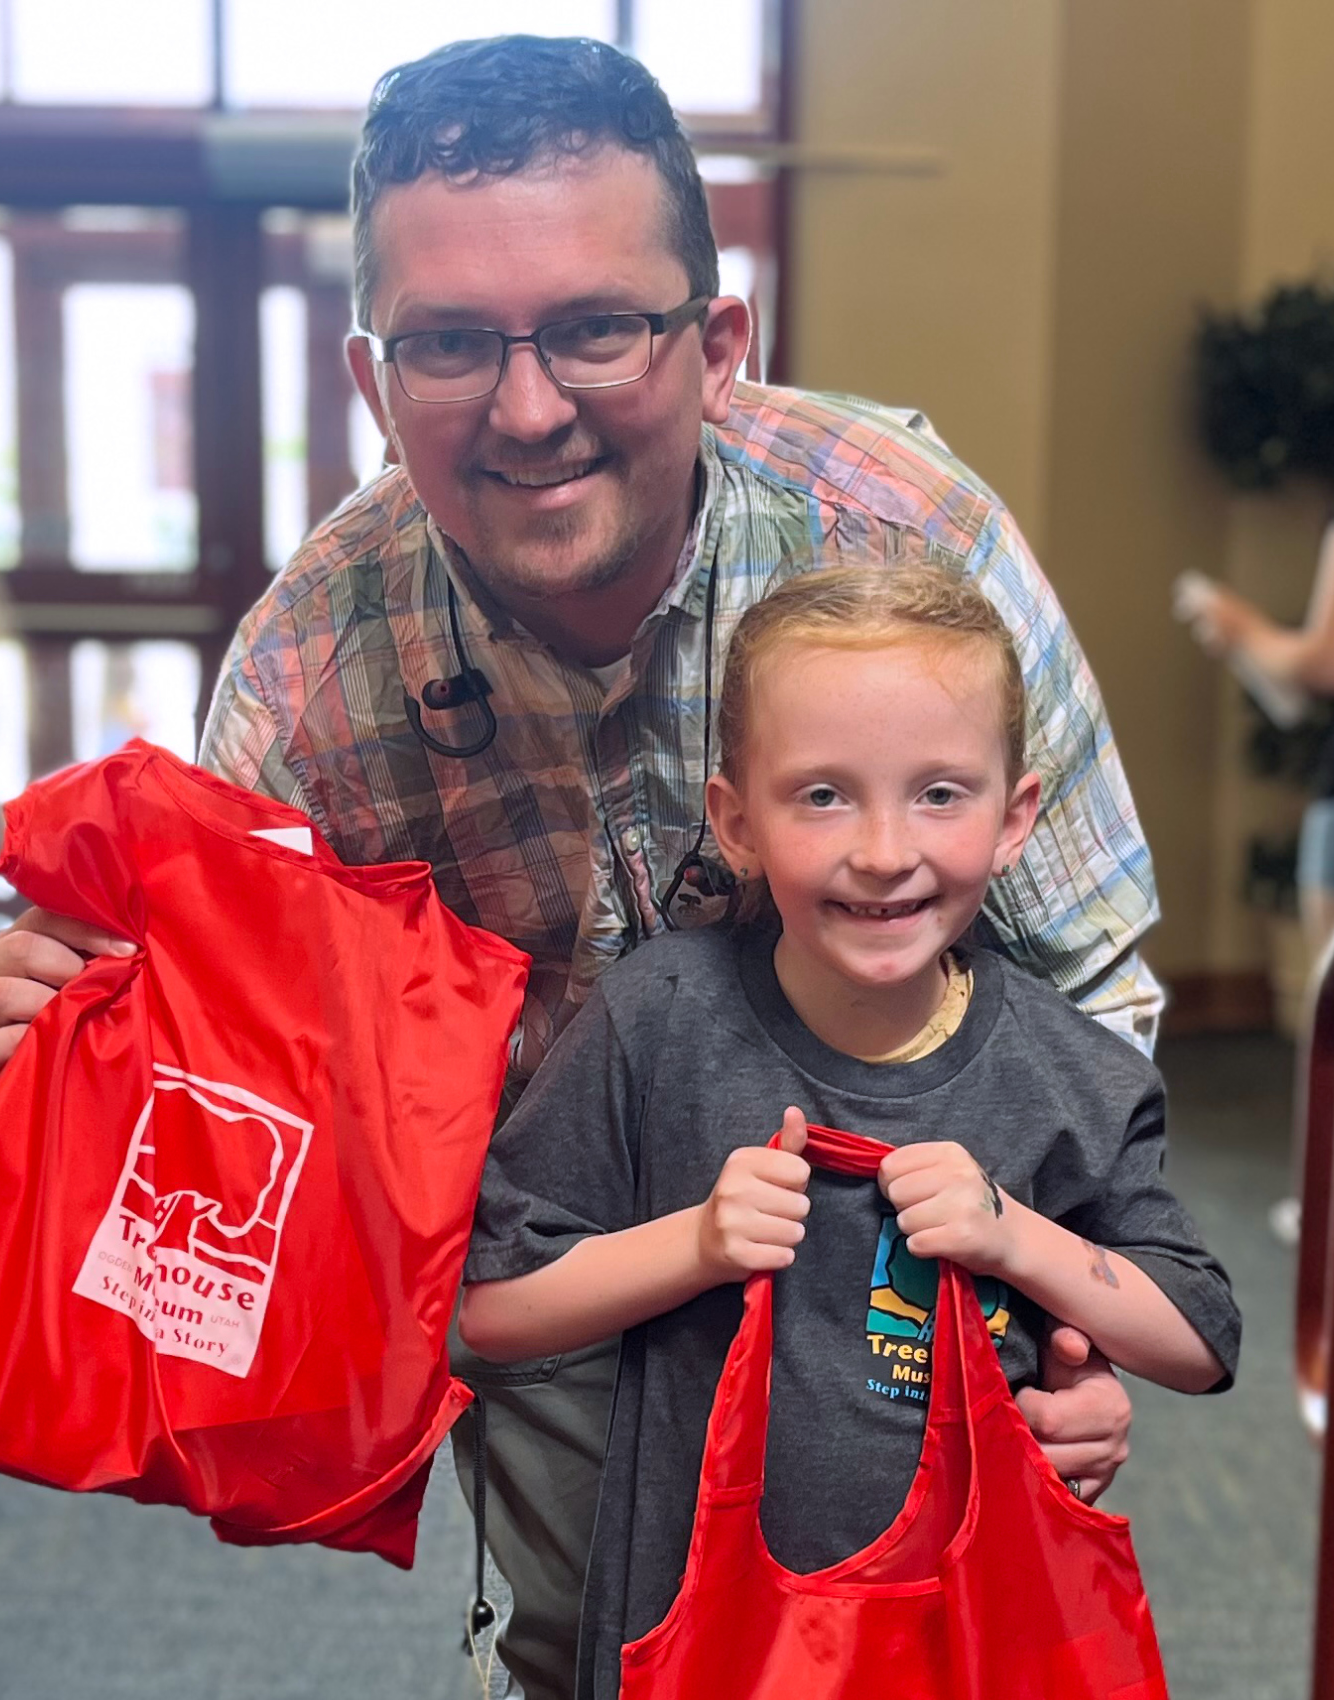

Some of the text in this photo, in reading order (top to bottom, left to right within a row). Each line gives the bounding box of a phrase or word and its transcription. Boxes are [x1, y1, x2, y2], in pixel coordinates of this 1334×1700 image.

[100, 1275, 136, 1310] Step
[172, 1328, 230, 1357] Story
[210, 1316, 240, 1328] UTAH
[892, 1364, 931, 1383] Mus
[866, 1378, 900, 1399] Step
